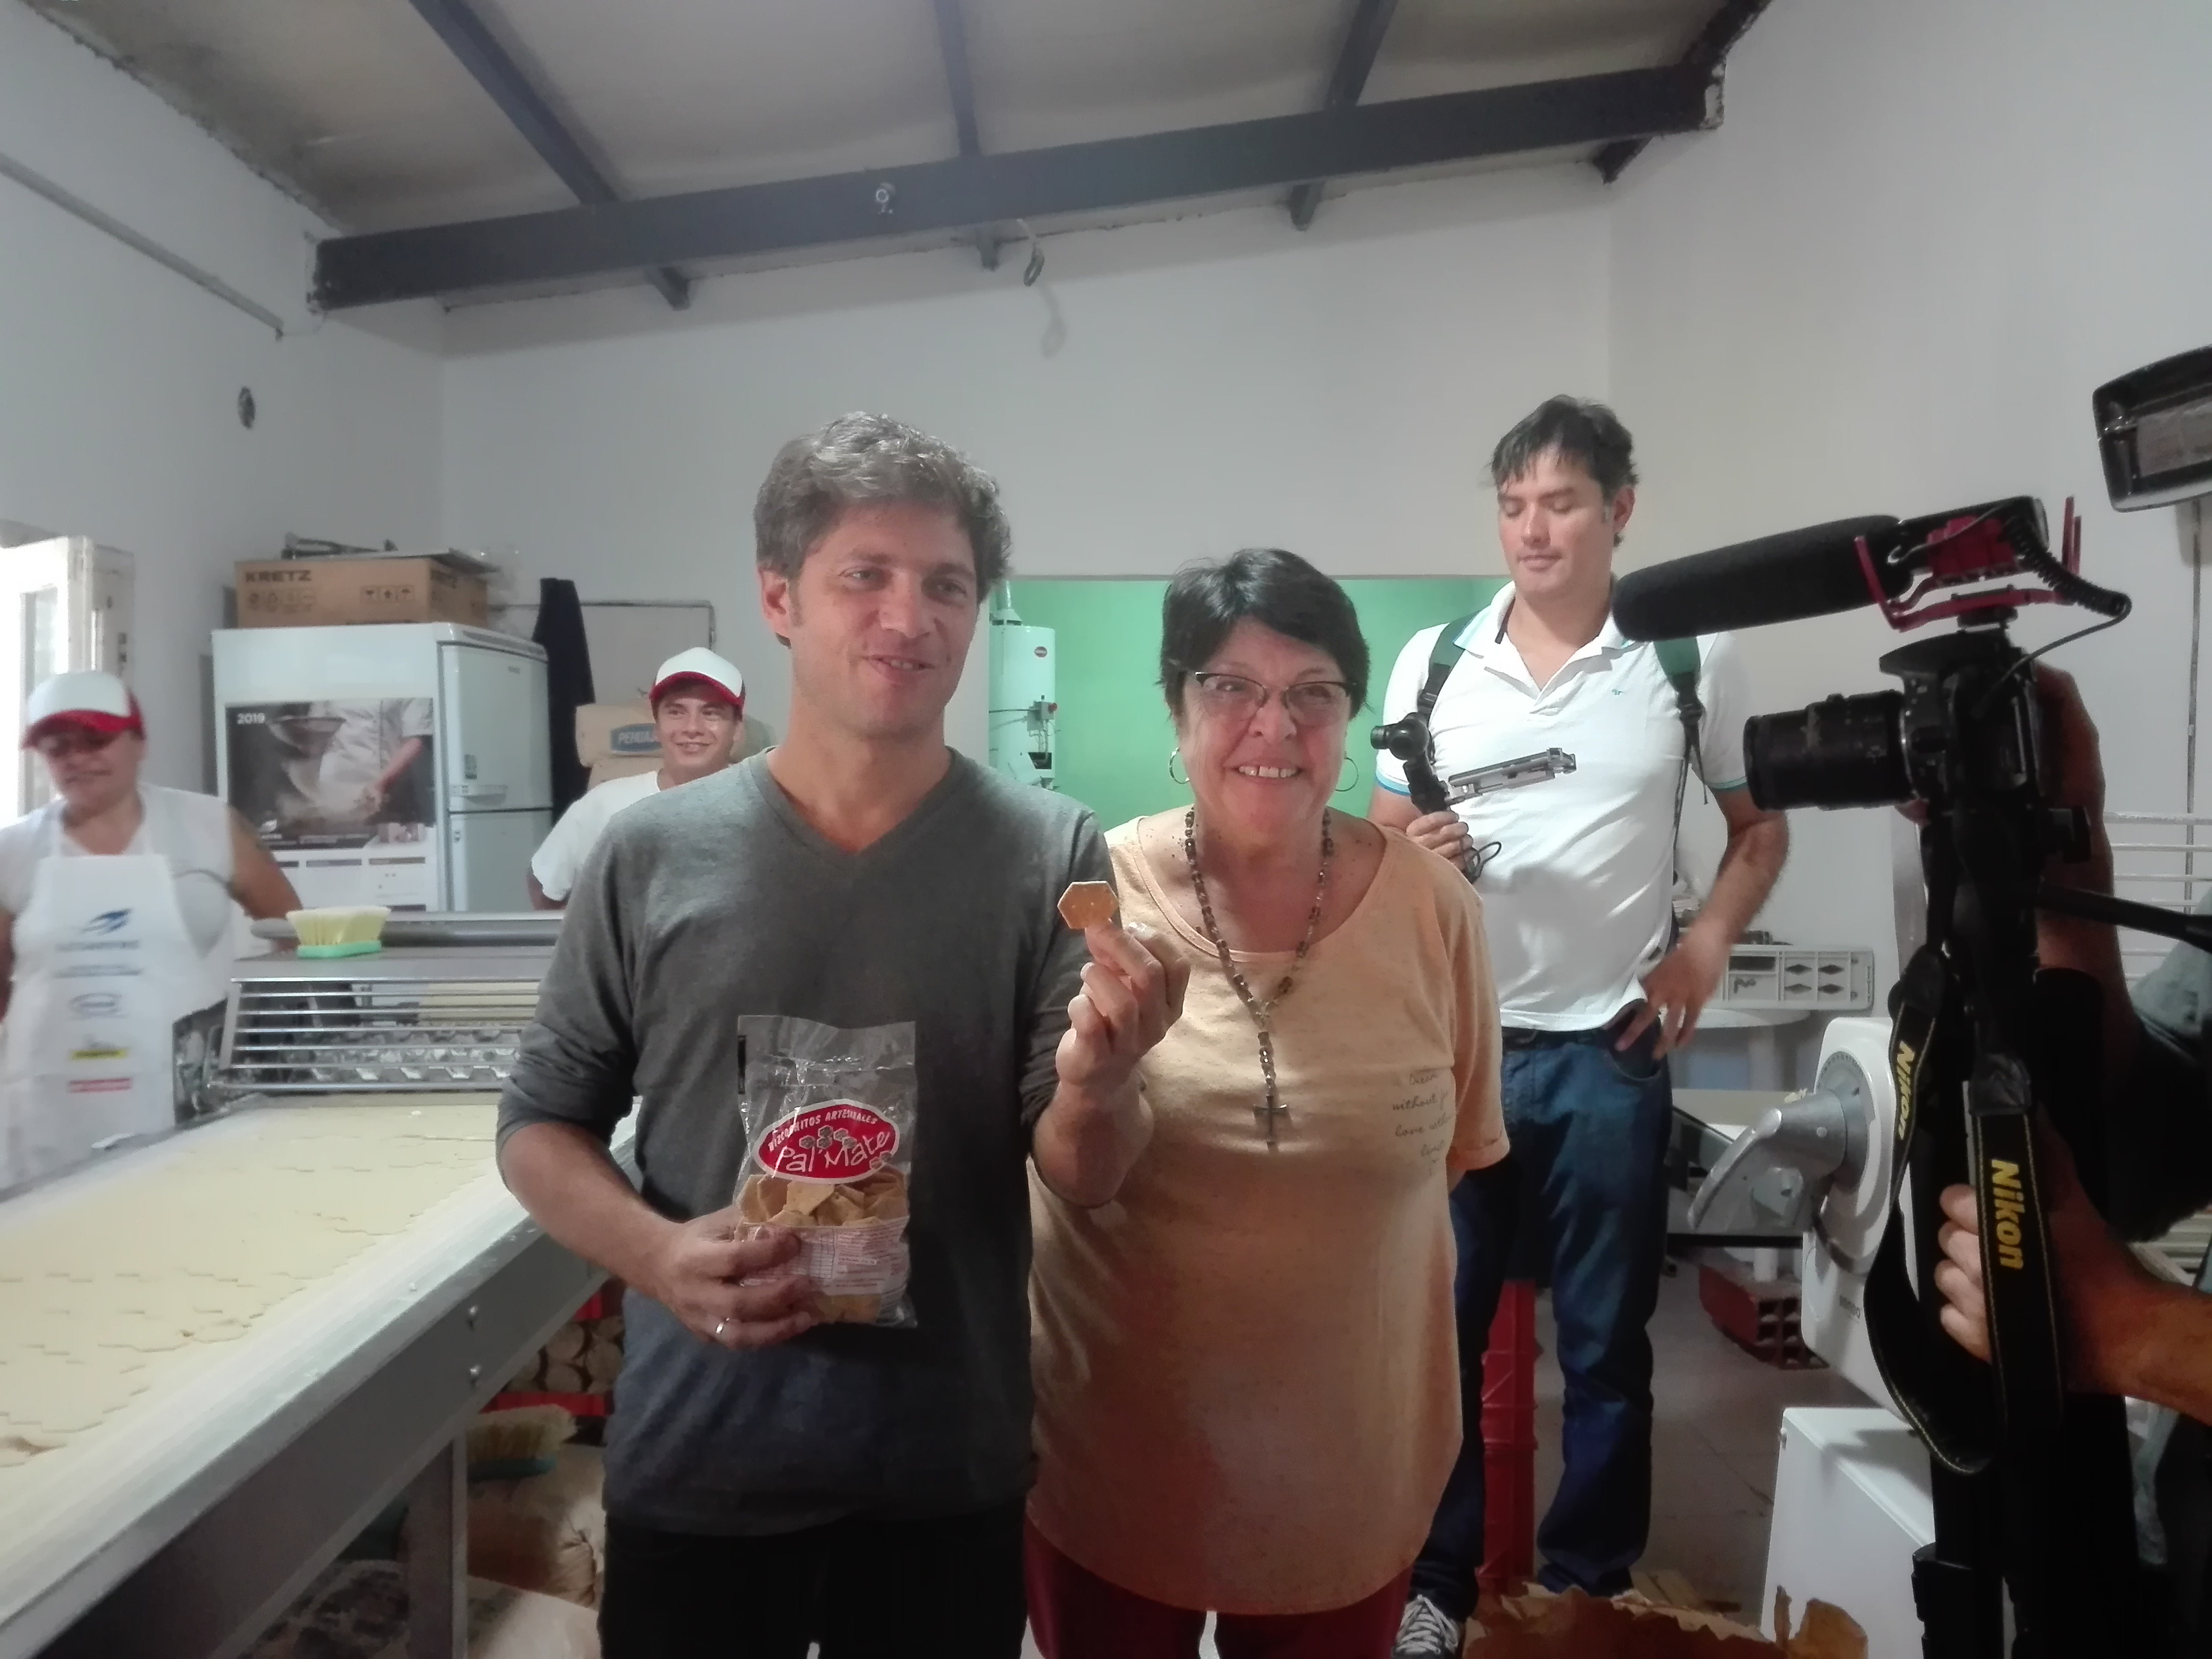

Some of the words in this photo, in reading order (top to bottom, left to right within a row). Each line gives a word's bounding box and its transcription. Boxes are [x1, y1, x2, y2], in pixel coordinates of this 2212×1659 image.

[246, 569, 311, 583] KRETZ
[237, 713, 265, 724] 2019
[1896, 1040, 1915, 1141] Nikon
[1991, 1159, 2025, 1269] Nikon
